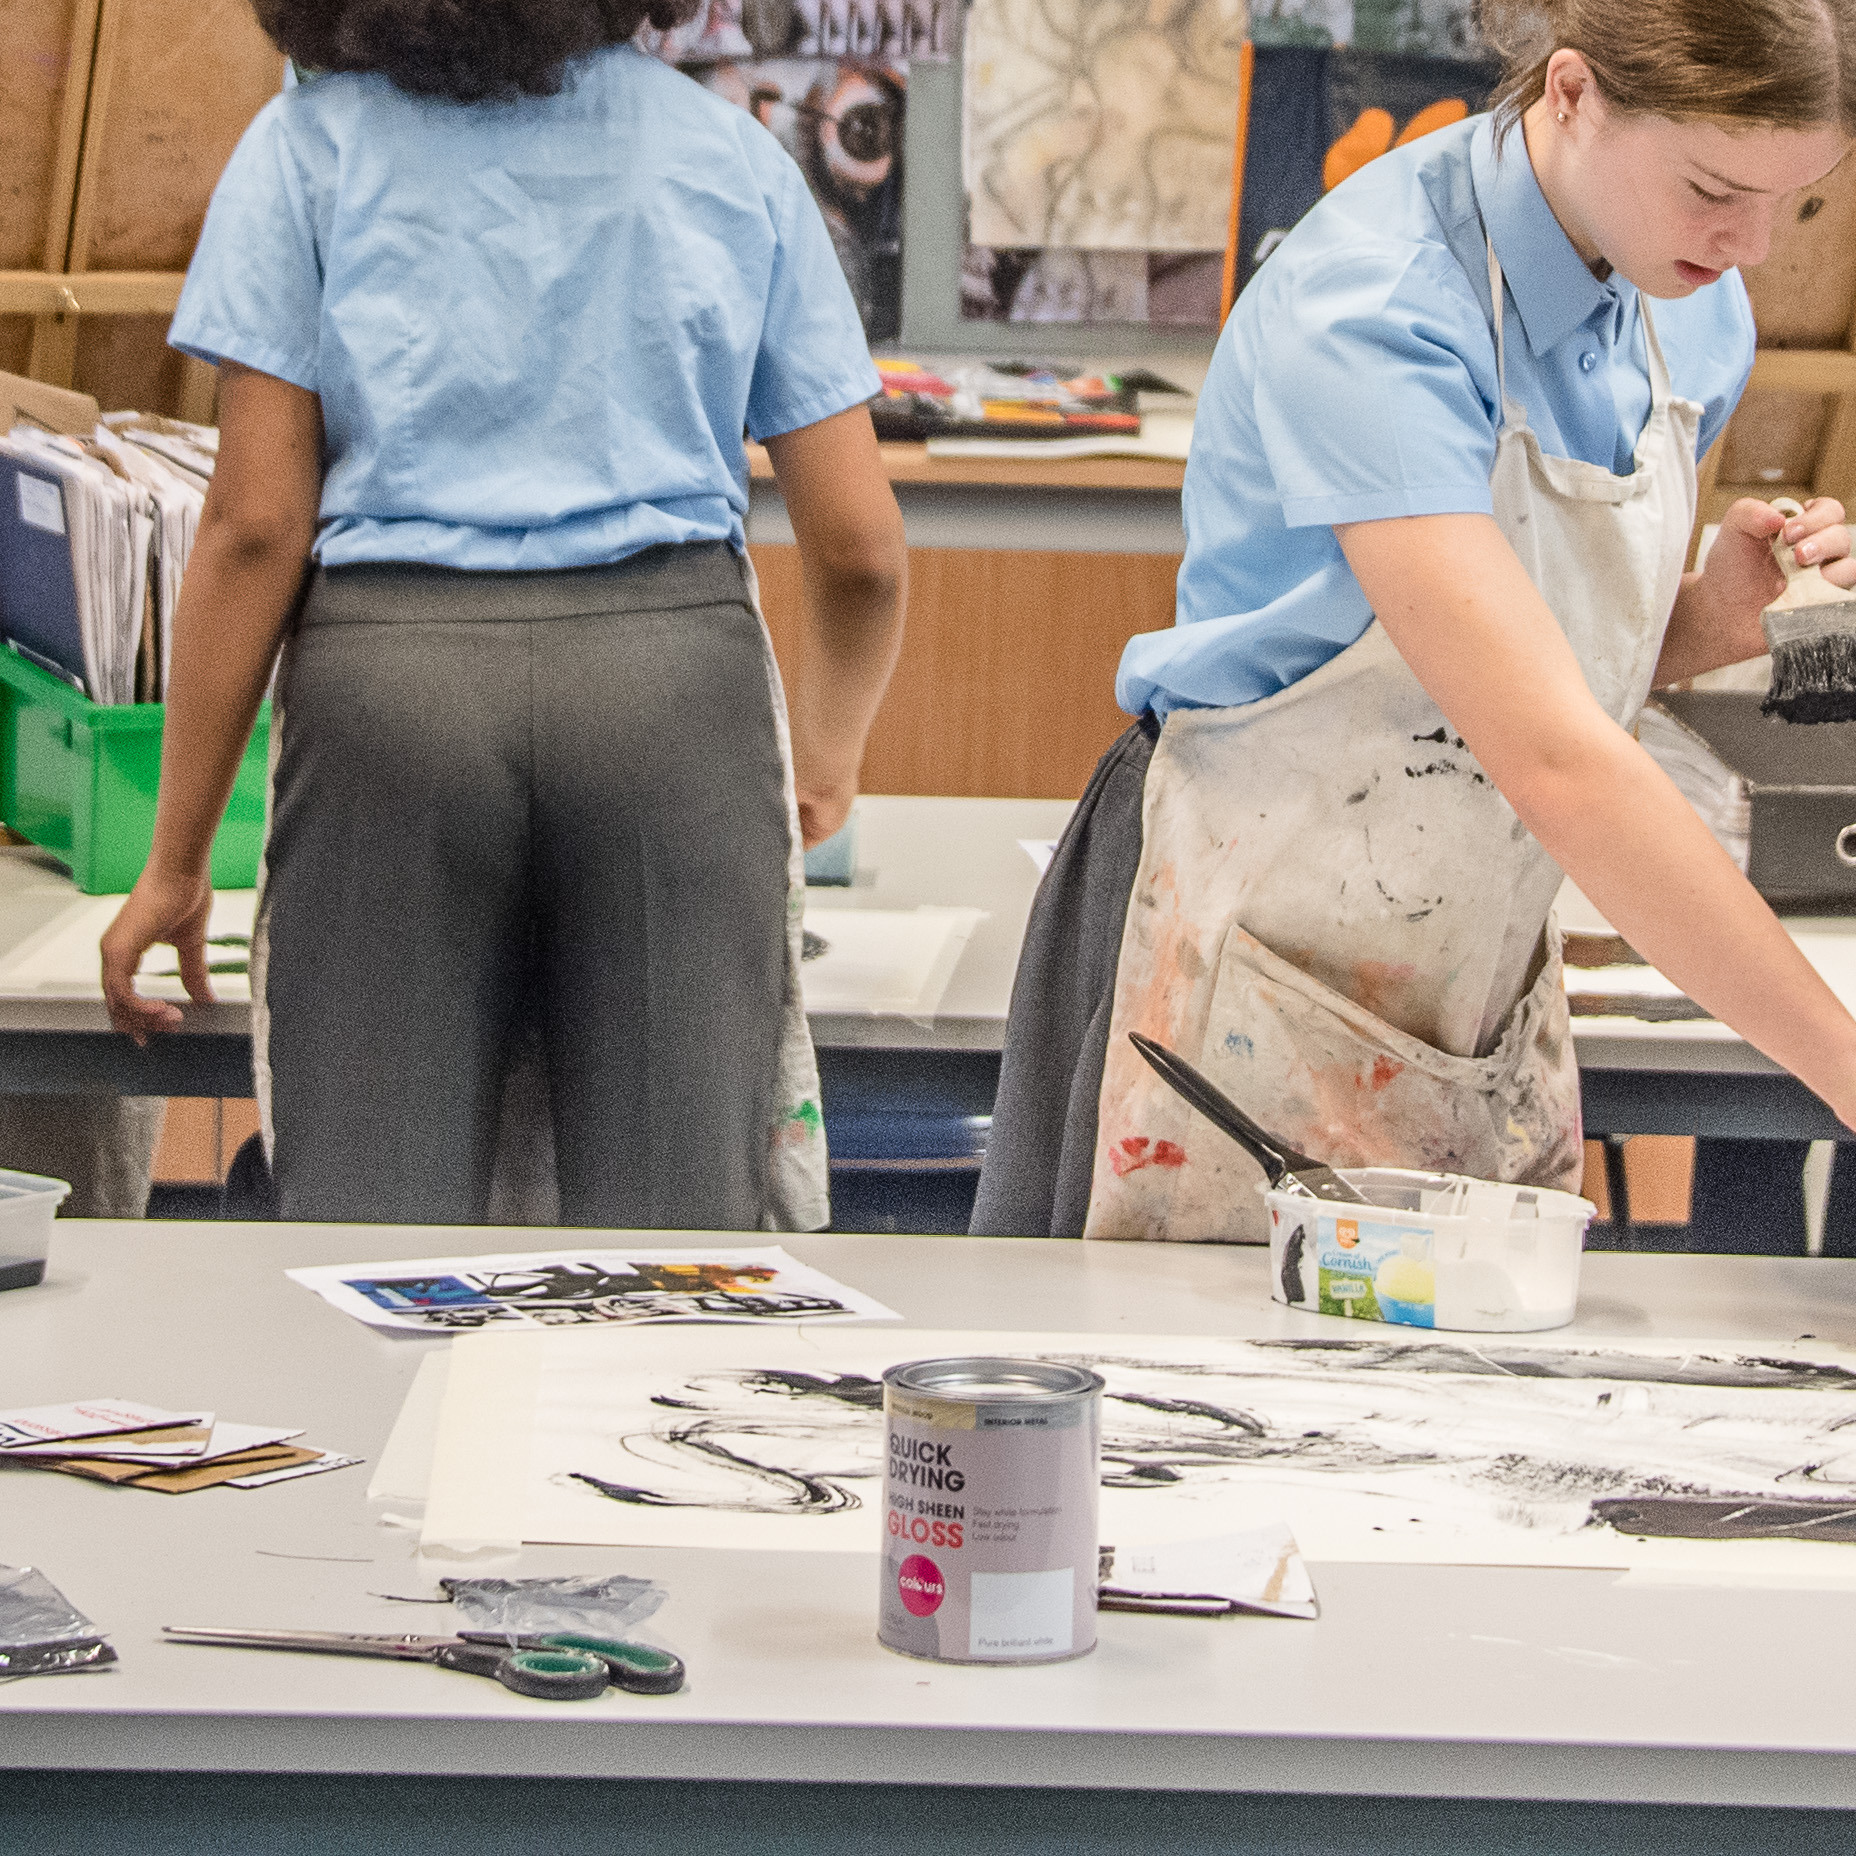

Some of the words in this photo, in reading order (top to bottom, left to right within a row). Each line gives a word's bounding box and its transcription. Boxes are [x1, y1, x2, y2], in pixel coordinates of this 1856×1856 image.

[1321, 1251, 1373, 1271] Cornish
[983, 1417, 1022, 1427] INTERIOR
[889, 1432, 953, 1467] QUICK
[888, 1456, 966, 1492] DRYING
[917, 1499, 965, 1520] SHEEN
[887, 1509, 964, 1549] GLOSS
[993, 1519, 1020, 1533] drying
[971, 1532, 991, 1543] Low
[899, 1574, 944, 1595] colours
[977, 1637, 999, 1648] Pure
[1033, 1636, 1055, 1647] white
